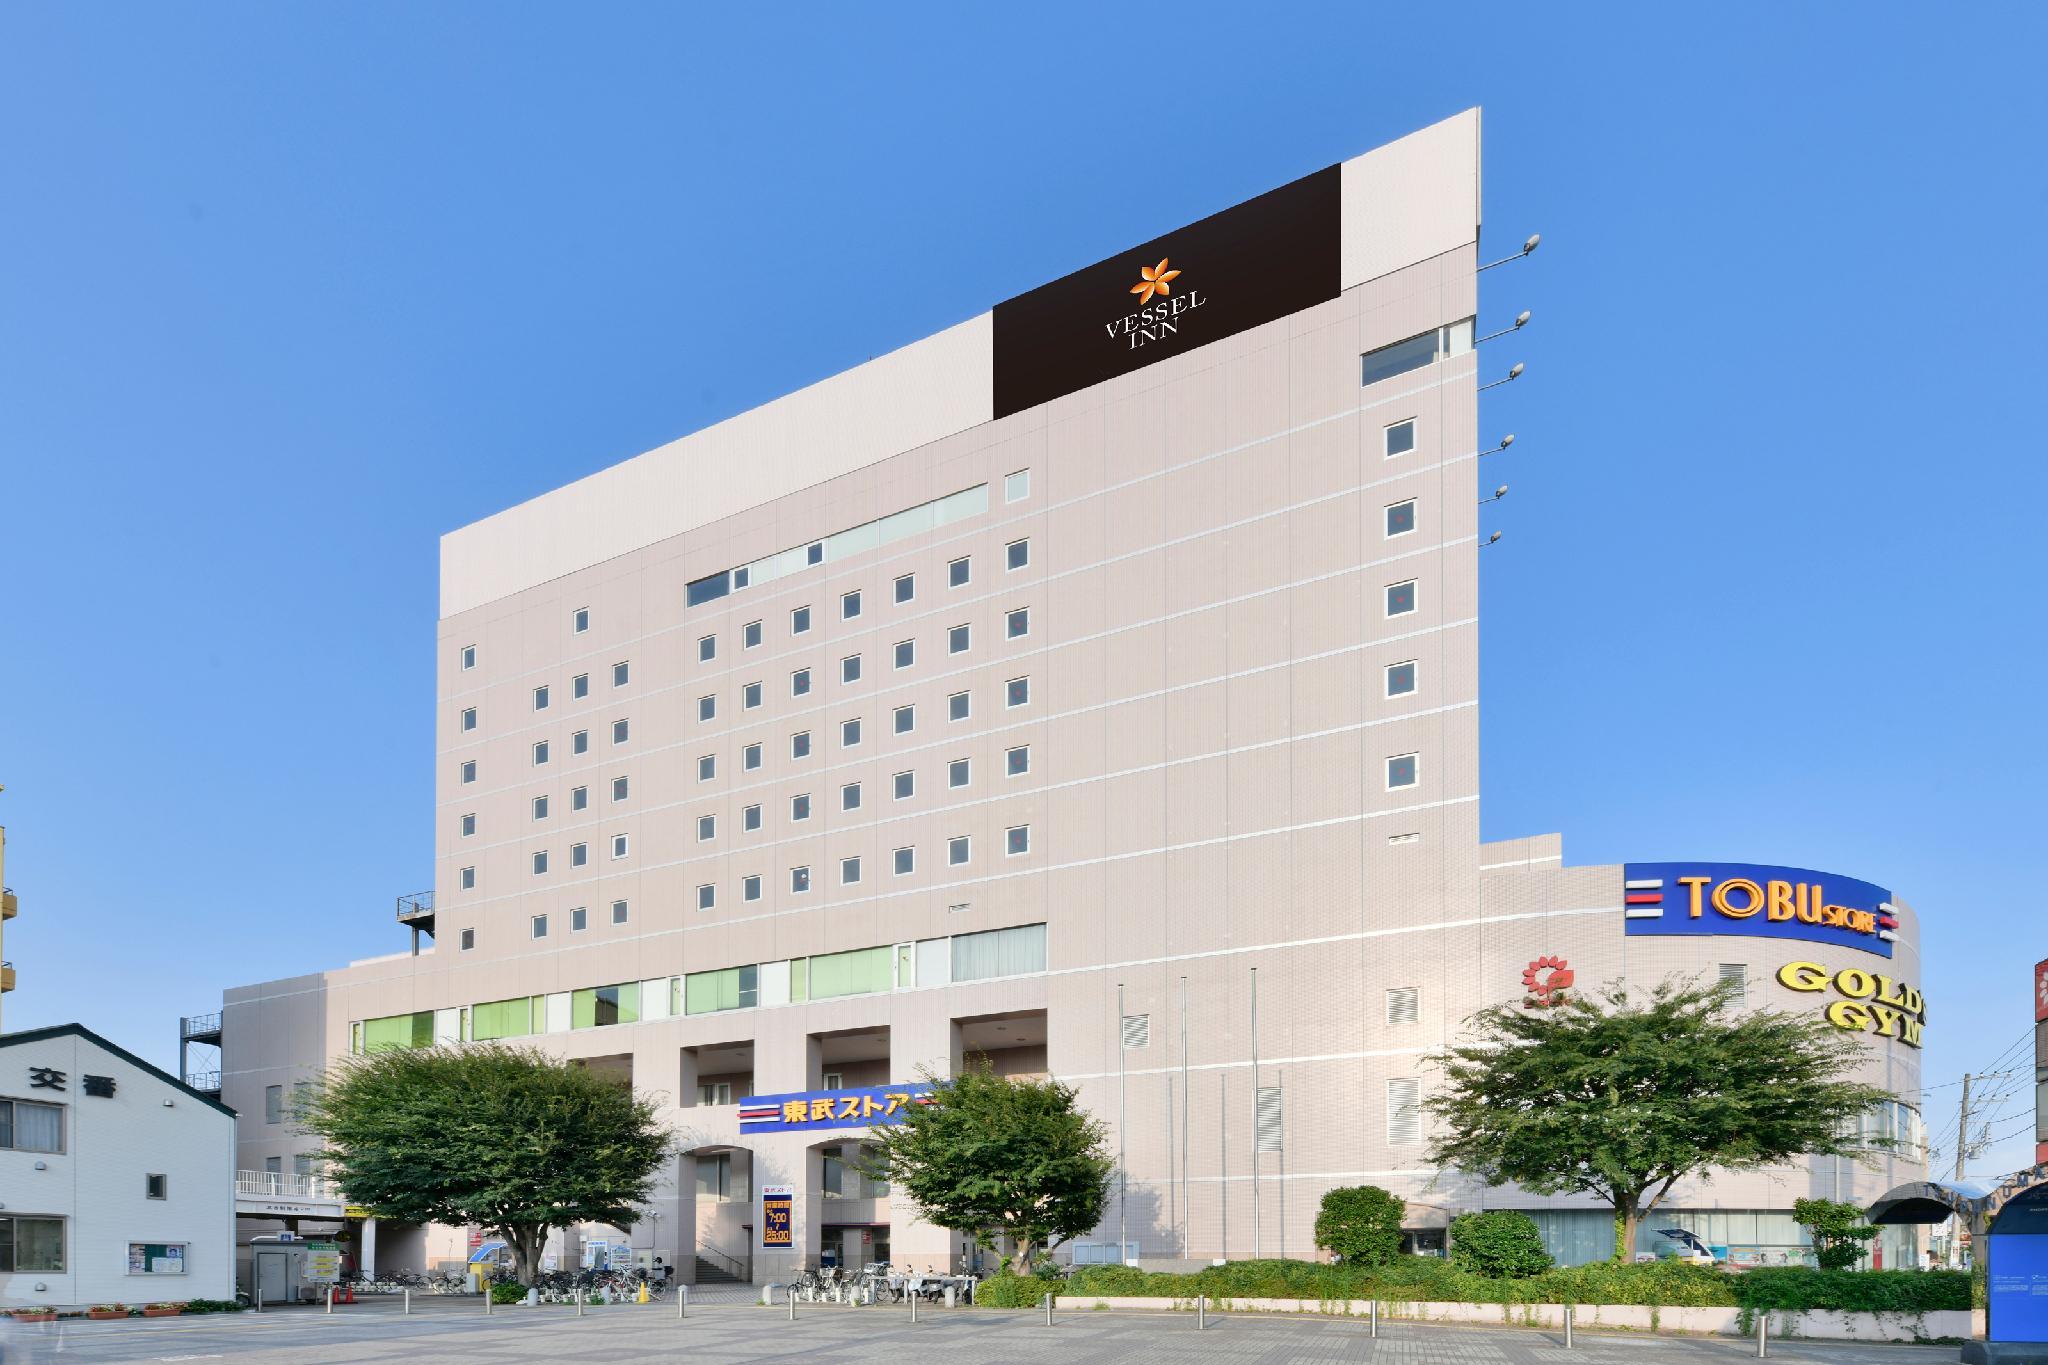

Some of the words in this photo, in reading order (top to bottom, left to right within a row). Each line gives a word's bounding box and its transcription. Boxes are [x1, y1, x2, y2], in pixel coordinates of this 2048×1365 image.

[1106, 290, 1207, 339] VESSEL
[1128, 317, 1179, 350] INN
[1678, 876, 1822, 923] TOBU
[1822, 904, 1877, 934] STORE
[1825, 1001, 1924, 1049] GYM
[28, 1066, 117, 1099] 交番
[783, 1093, 910, 1124] 東武ストア
[769, 1212, 787, 1223] 7:00
[766, 1230, 789, 1241] 25:00
